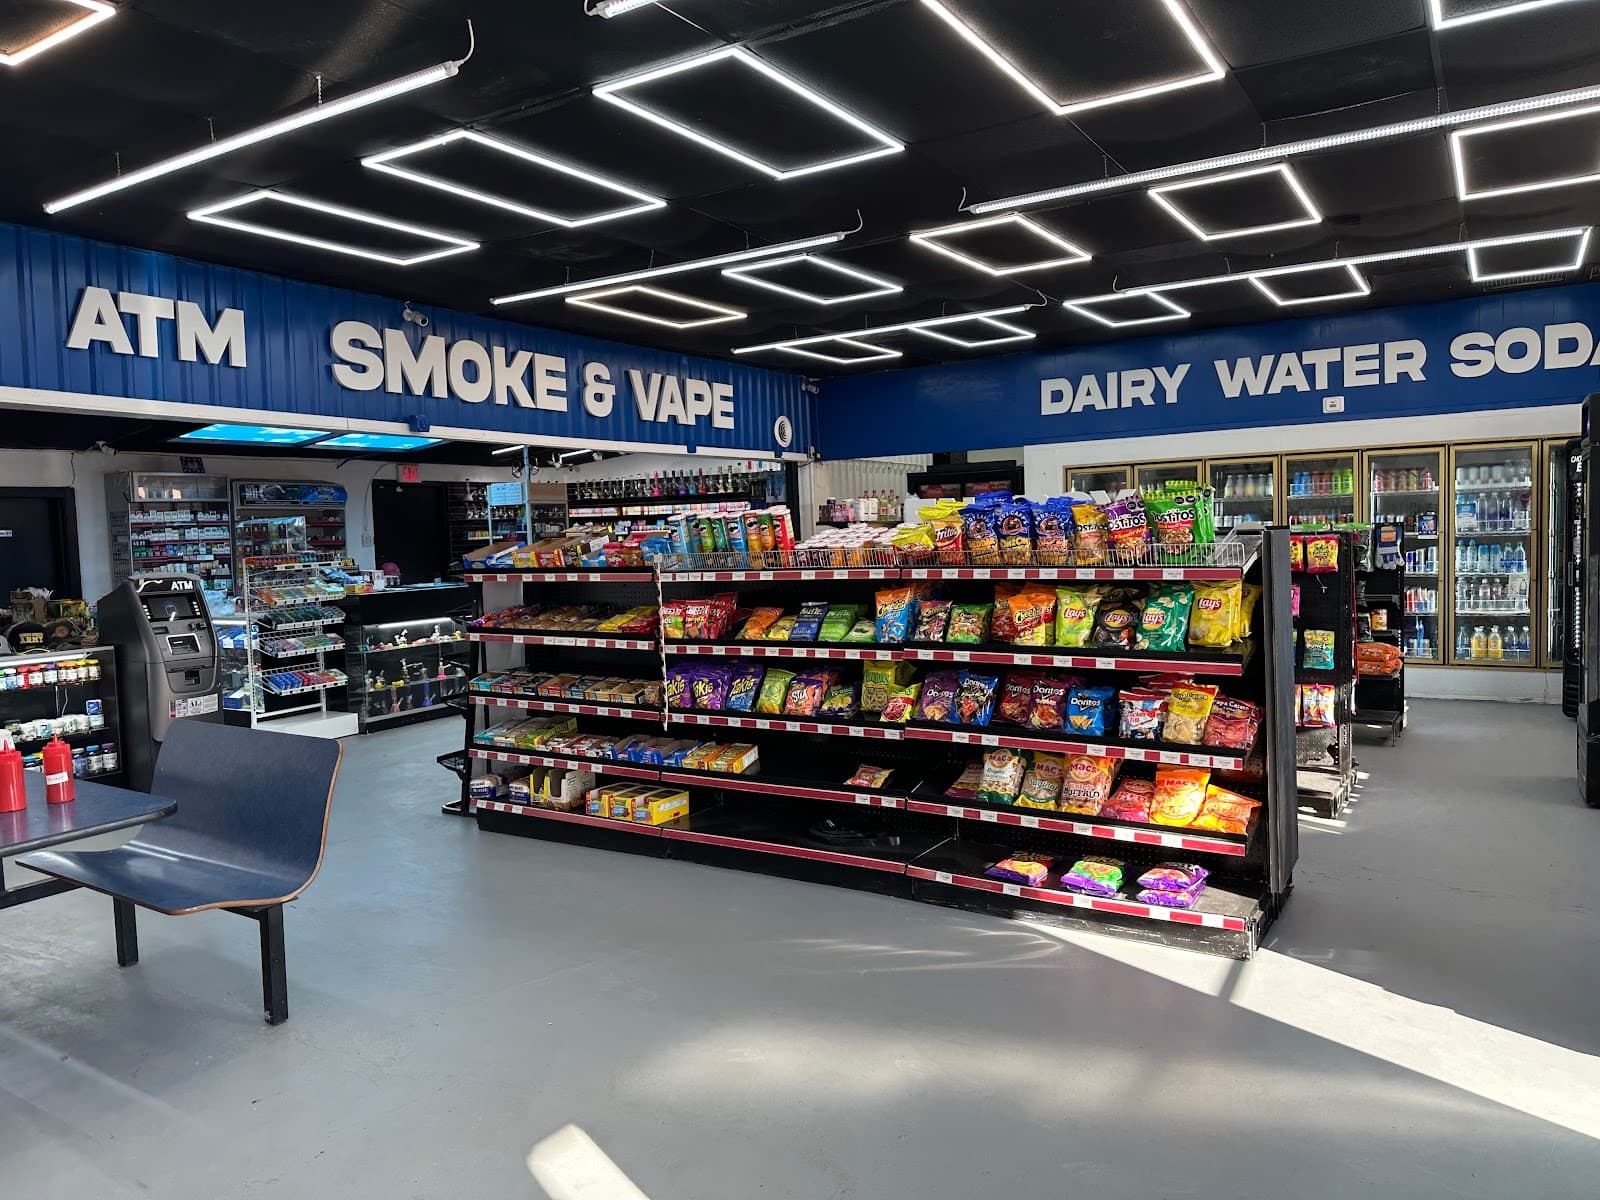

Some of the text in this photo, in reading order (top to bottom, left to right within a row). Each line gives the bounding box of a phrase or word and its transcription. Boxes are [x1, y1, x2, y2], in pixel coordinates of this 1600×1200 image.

[67, 285, 248, 368] ATM
[330, 319, 736, 431] SMOKE & VAPE
[1040, 321, 1600, 416] DAIRY WATER SOD
[935, 526, 959, 541] Fritos
[171, 580, 193, 591] ATM
[729, 678, 754, 698] Takis
[1033, 685, 1065, 696] Doritos
[1071, 697, 1102, 706] Doritos
